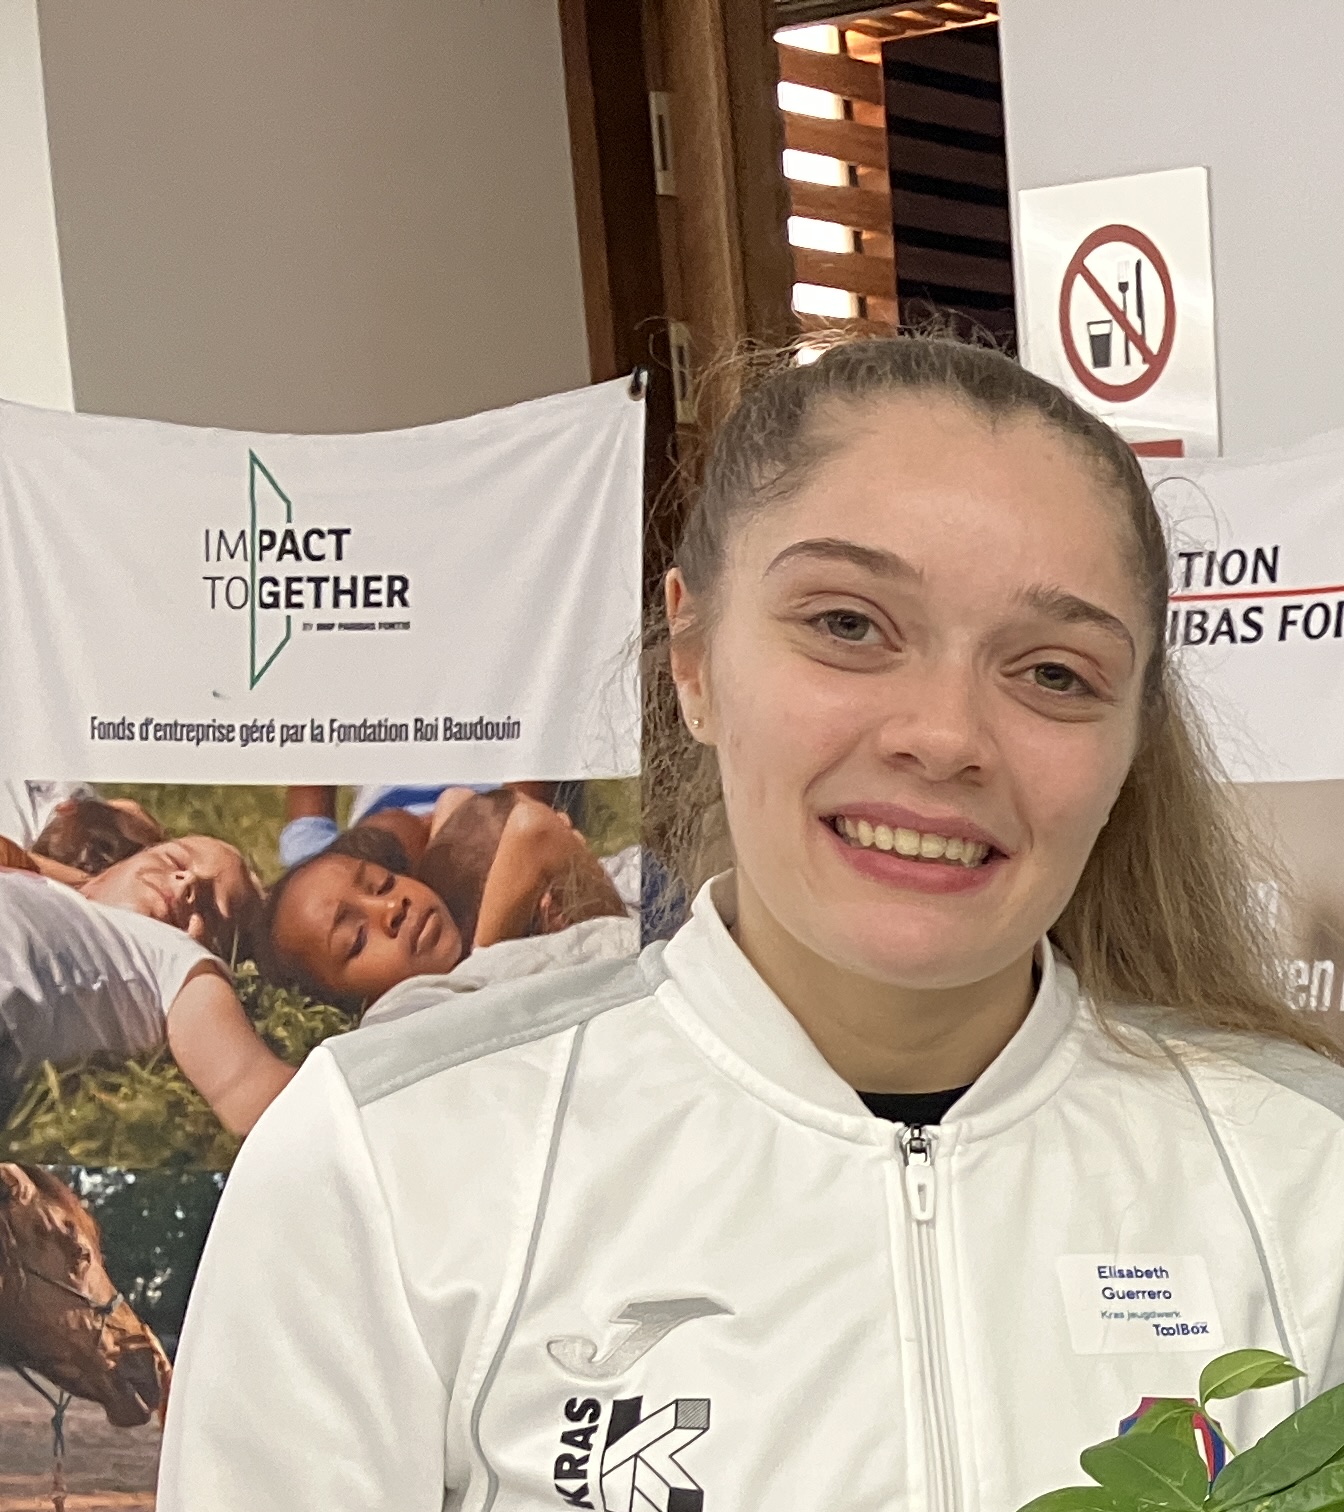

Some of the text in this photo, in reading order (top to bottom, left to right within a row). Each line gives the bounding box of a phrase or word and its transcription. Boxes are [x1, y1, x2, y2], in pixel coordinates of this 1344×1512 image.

[204, 528, 352, 562] IMPACT
[202, 574, 410, 610] TOGETHER
[90, 715, 521, 748] Fonds d'entreprise géré par la Fondation Roi Baudouin
[1097, 1265, 1169, 1279] Elisabeth
[1101, 1286, 1172, 1300] Guerrero
[1152, 1323, 1210, 1337] ToolBox
[553, 1397, 602, 1511] KRAS
